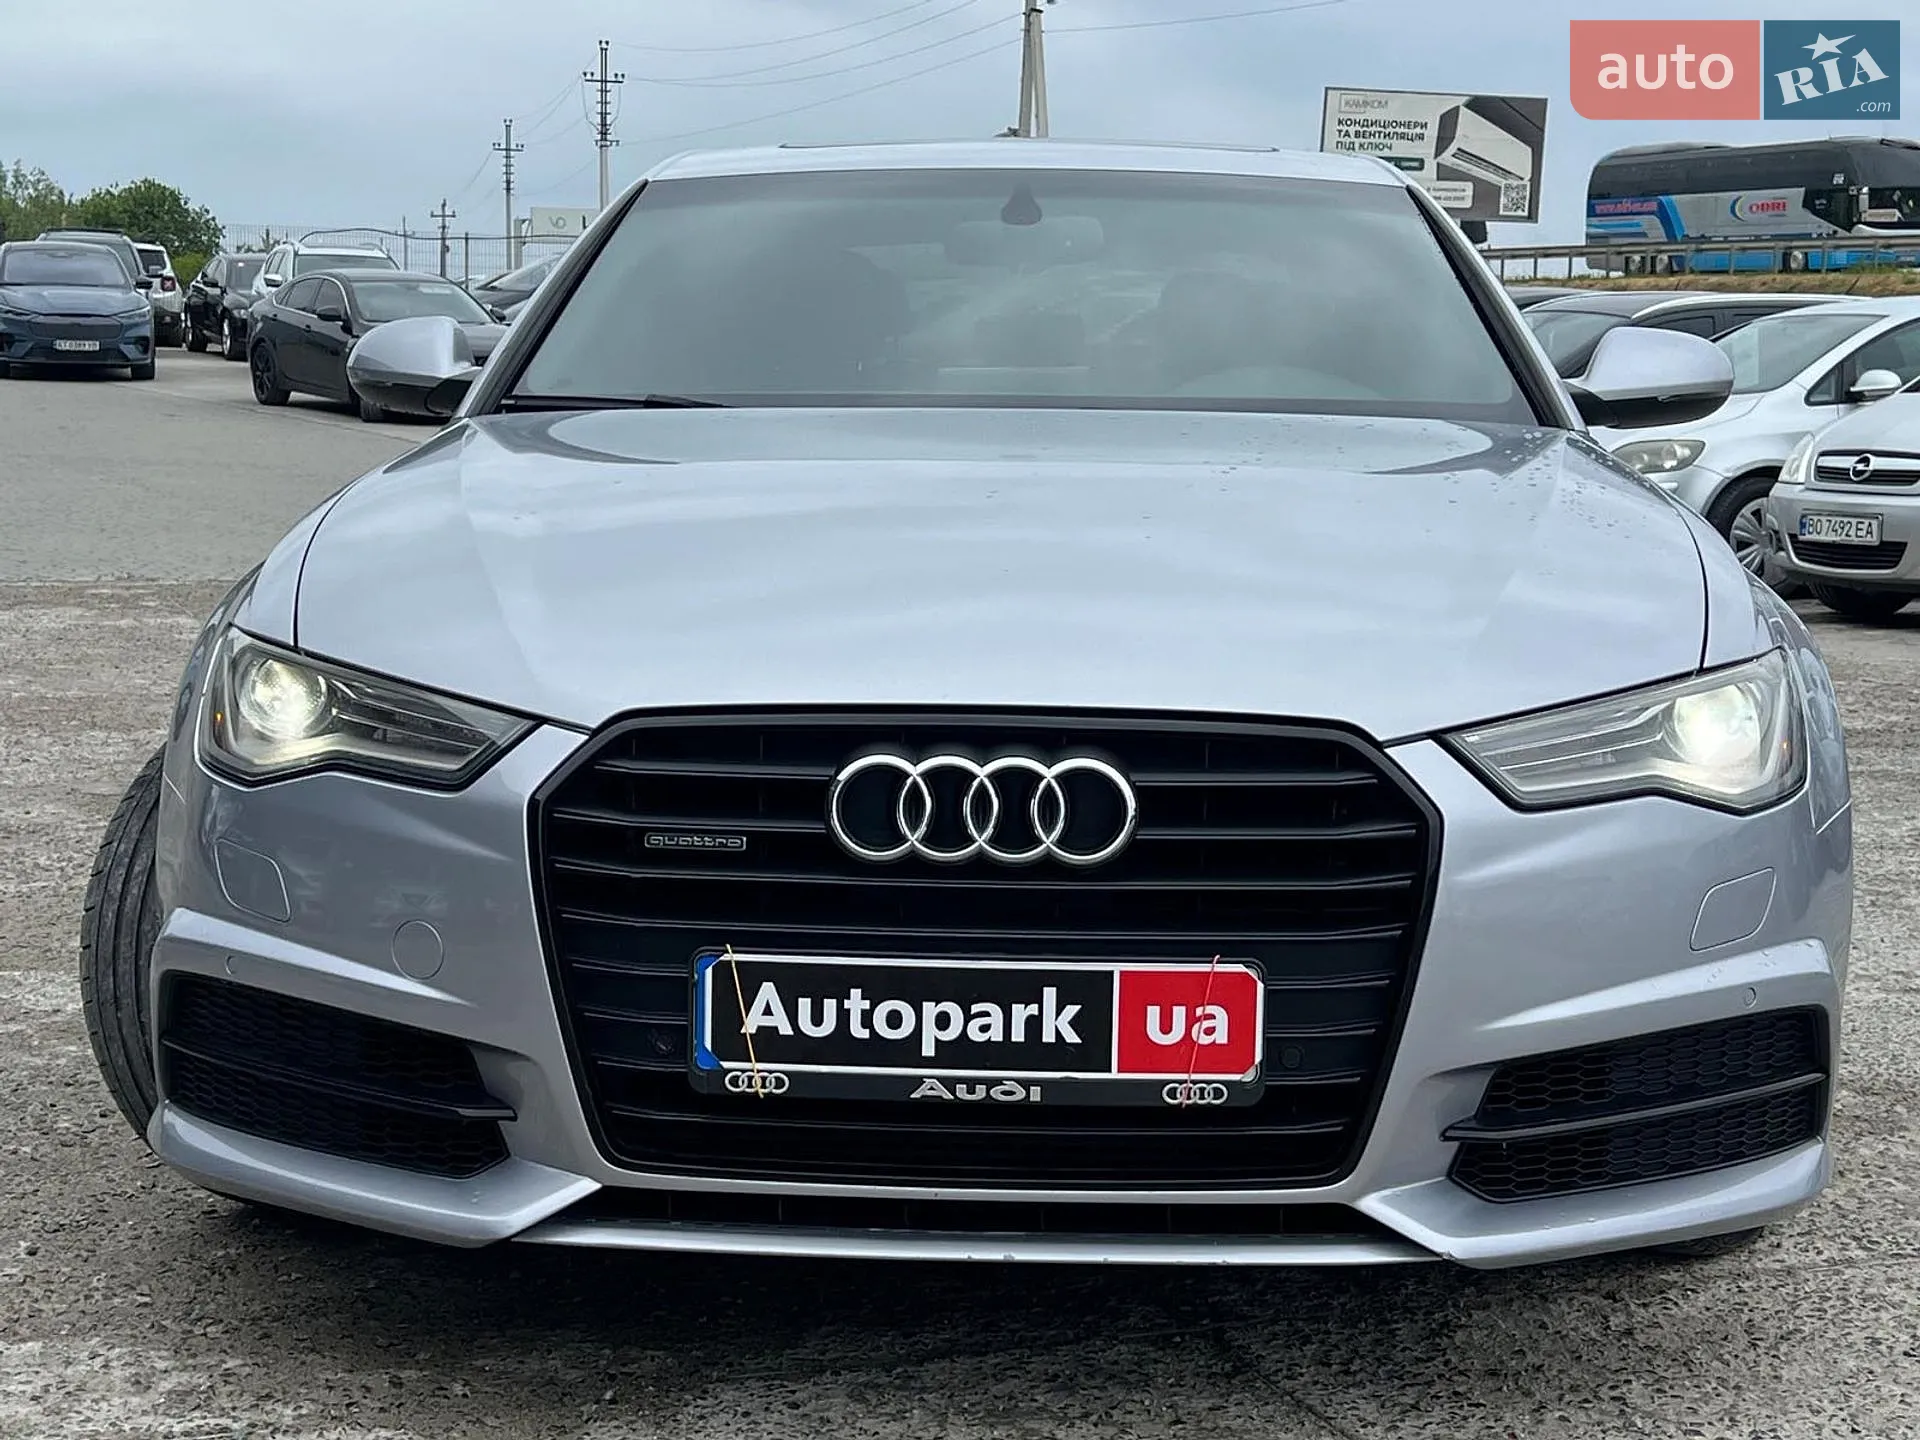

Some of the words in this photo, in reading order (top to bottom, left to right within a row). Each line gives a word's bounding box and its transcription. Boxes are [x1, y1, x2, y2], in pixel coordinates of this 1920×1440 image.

[1337, 117, 1428, 131] КОНДИЦІОНЕРИ
[1336, 129, 1351, 139] ТА
[1354, 129, 1425, 142] ВЕНТИЛЯЦІЯ
[1335, 140, 1356, 152] ПІД
[1359, 141, 1393, 152] КЛЮЧ
[1825, 519, 1853, 538] 7492
[1855, 520, 1874, 539] EA
[649, 836, 741, 847] quattro
[741, 981, 1083, 1057] Autopark
[1144, 1001, 1230, 1046] ua
[909, 1078, 1041, 1102] Audi
